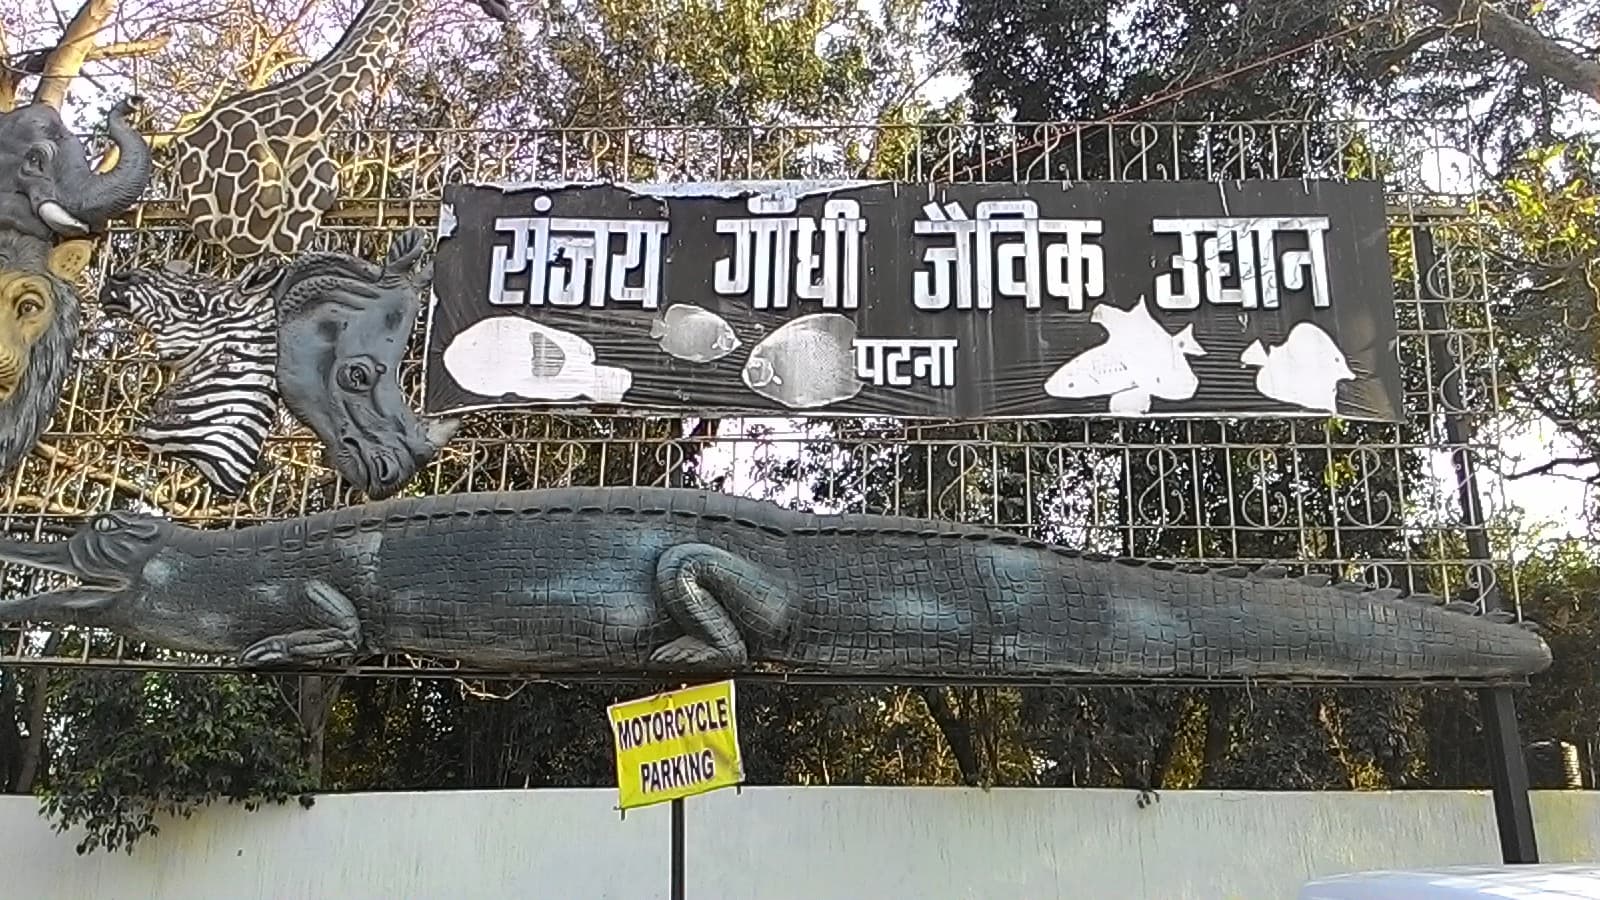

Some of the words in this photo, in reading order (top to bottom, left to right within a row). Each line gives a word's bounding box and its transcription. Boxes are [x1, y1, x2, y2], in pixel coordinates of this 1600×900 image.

[490, 195, 671, 309] संजय
[913, 200, 1106, 311] जैविक
[1152, 215, 1330, 309] उद्यान
[853, 339, 958, 387] पटना
[617, 698, 728, 751] MOTORCYCLE
[640, 749, 715, 794] PARKING
